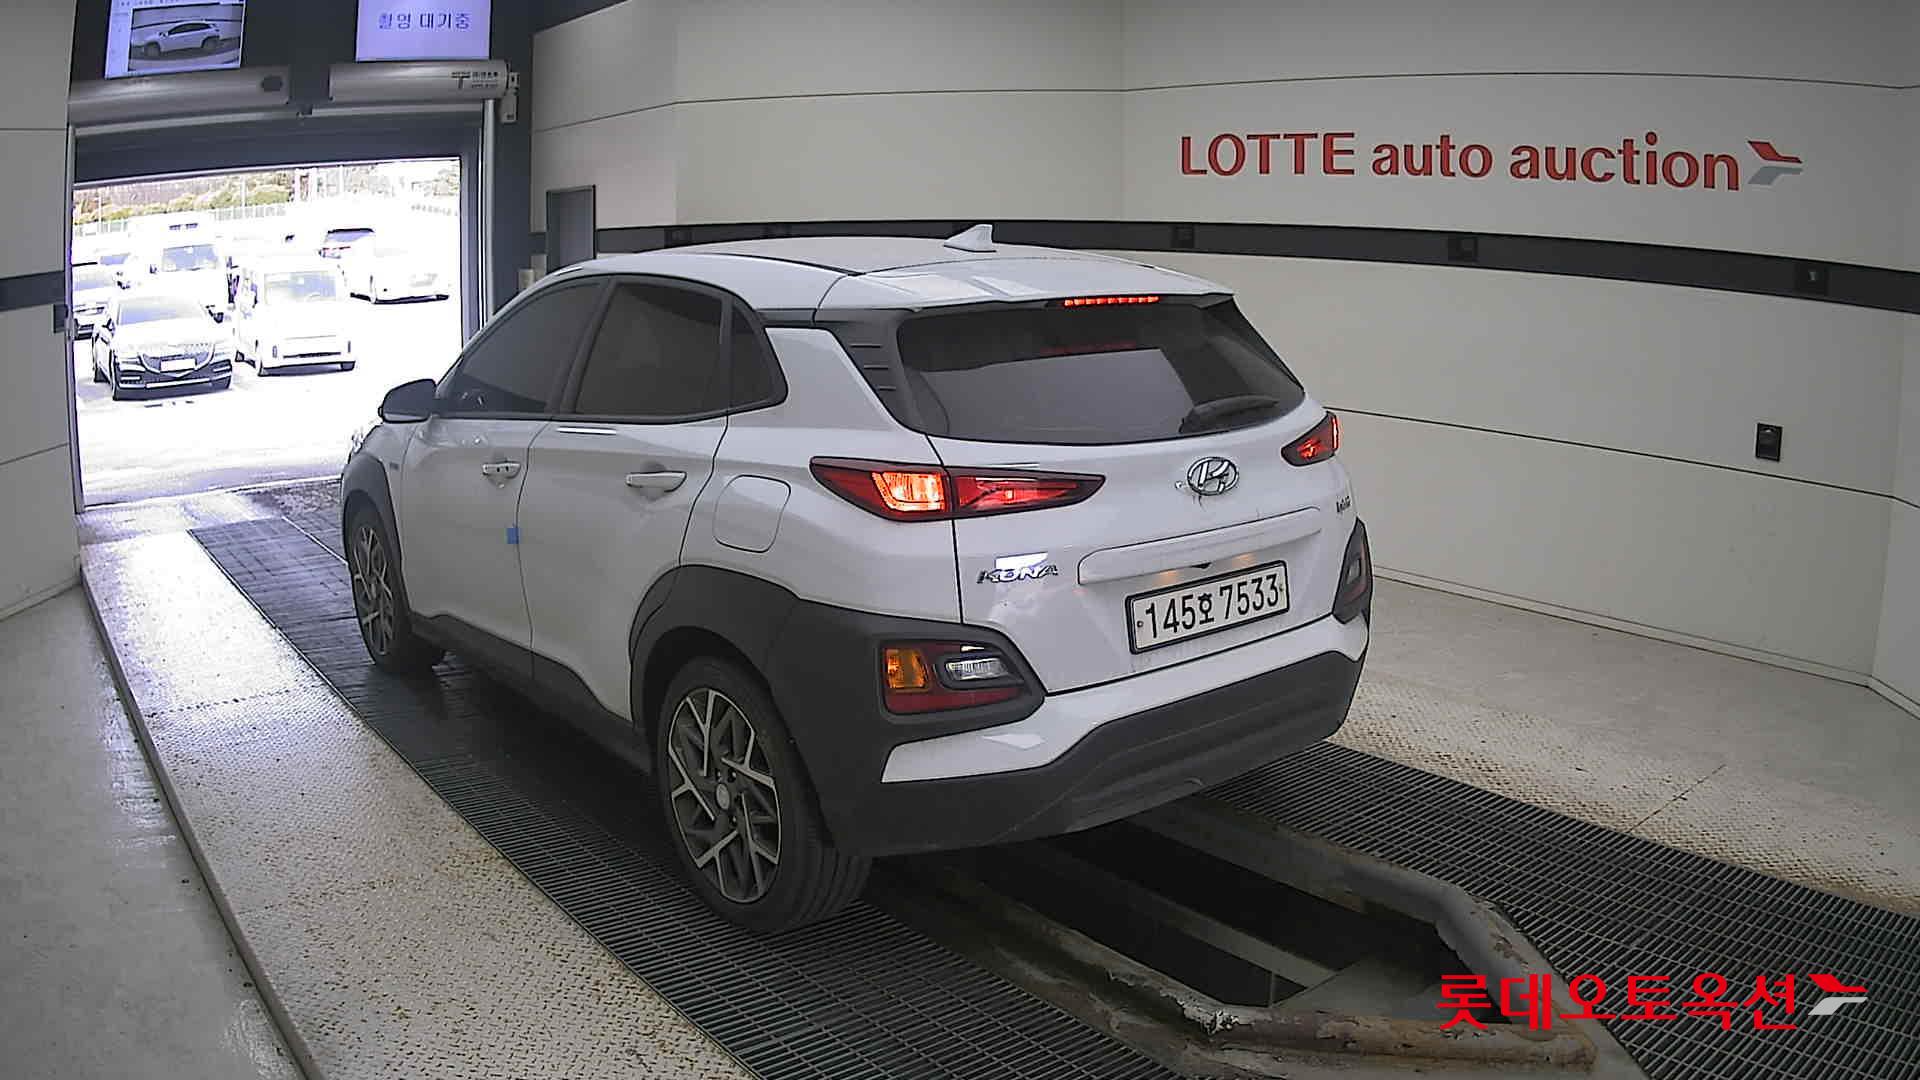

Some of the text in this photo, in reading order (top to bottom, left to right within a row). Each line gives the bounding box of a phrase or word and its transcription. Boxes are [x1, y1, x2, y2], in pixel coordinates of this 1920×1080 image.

[419, 12, 470, 30] 대기중
[1181, 131, 1739, 191] LOTTE auto auction
[976, 564, 1059, 584] KONA
[1145, 573, 1279, 639] 145호 7533
